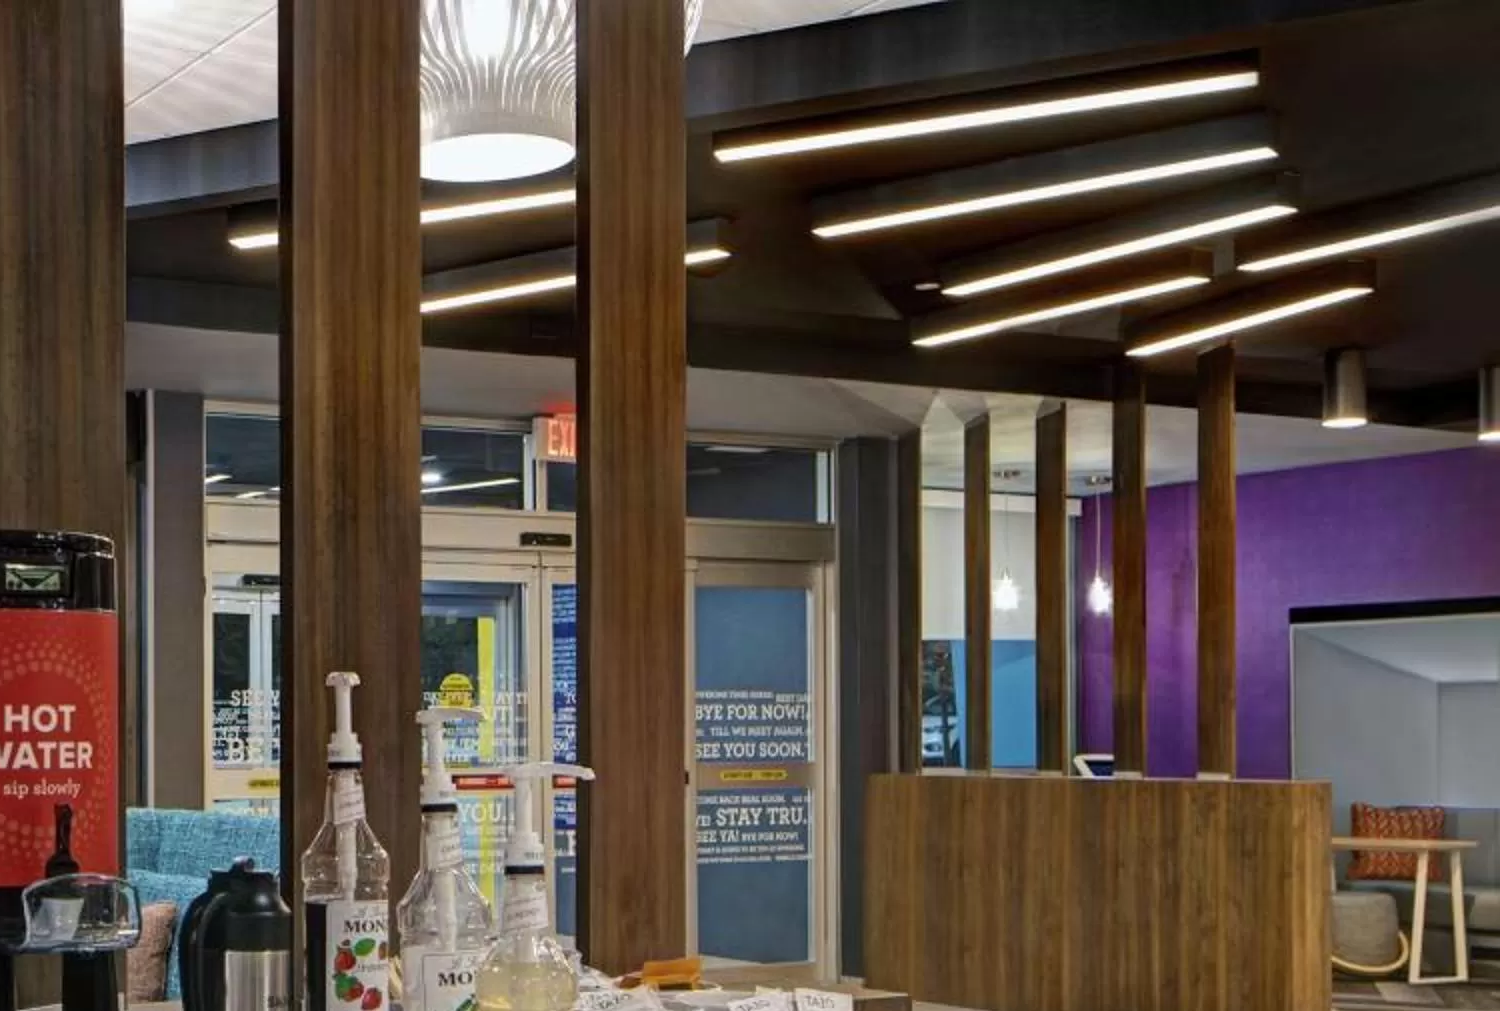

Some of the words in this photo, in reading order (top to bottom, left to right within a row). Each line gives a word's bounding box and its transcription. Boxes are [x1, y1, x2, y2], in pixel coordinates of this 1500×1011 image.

[3, 704, 76, 733] HOT
[727, 704, 758, 720] FOR
[723, 743, 756, 757] YOU
[759, 742, 805, 757] SOON.
[3, 780, 30, 799] sip
[33, 778, 81, 798] slowly
[715, 807, 763, 826] STAY
[765, 807, 807, 825] TRU.
